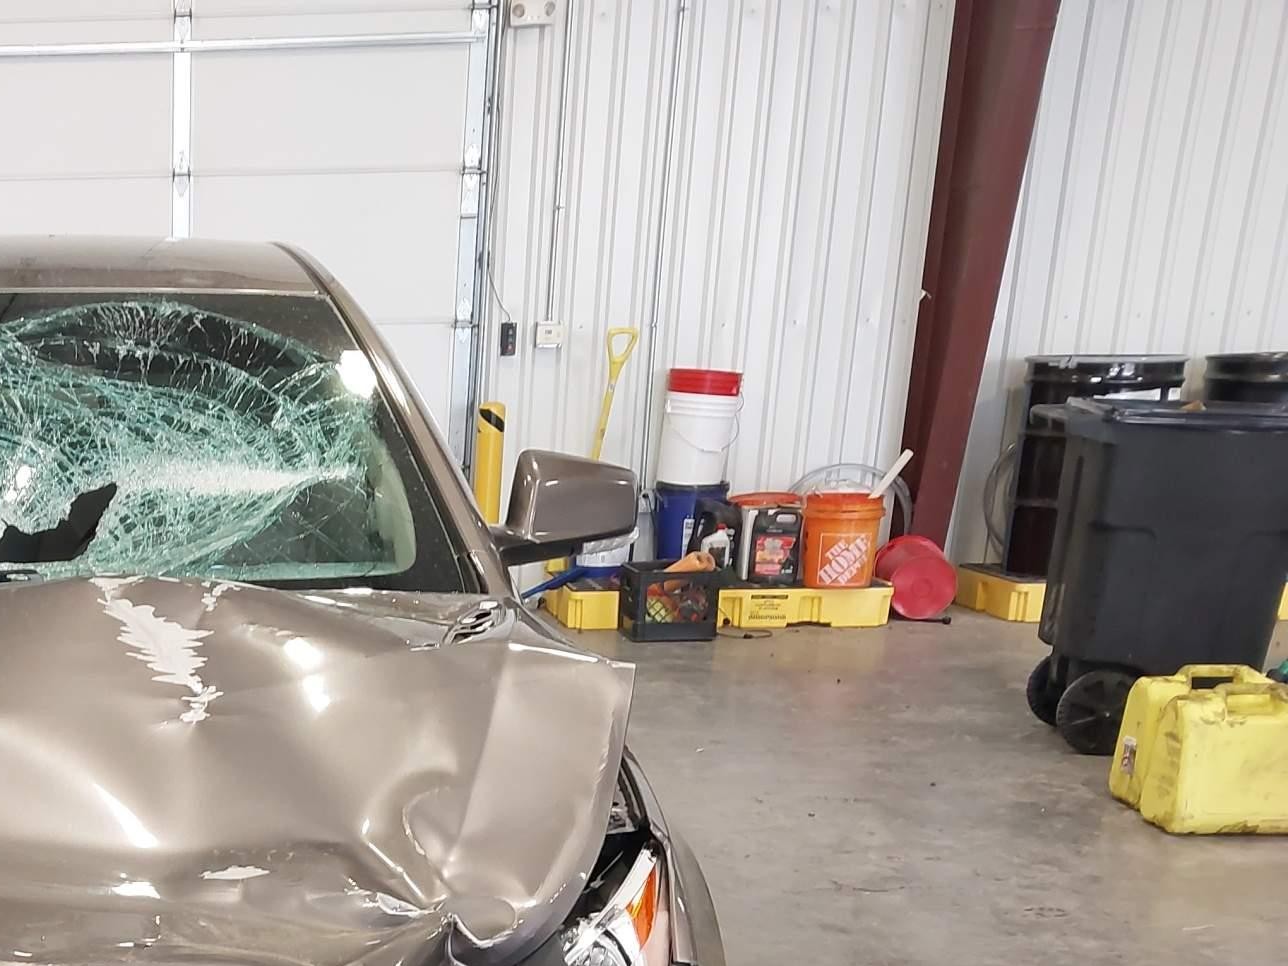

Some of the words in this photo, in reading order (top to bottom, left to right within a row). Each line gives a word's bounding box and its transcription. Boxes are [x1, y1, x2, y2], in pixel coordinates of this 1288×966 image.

[819, 533, 869, 585] HOME
[825, 539, 849, 560] THE
[838, 554, 868, 585] DEPOT
